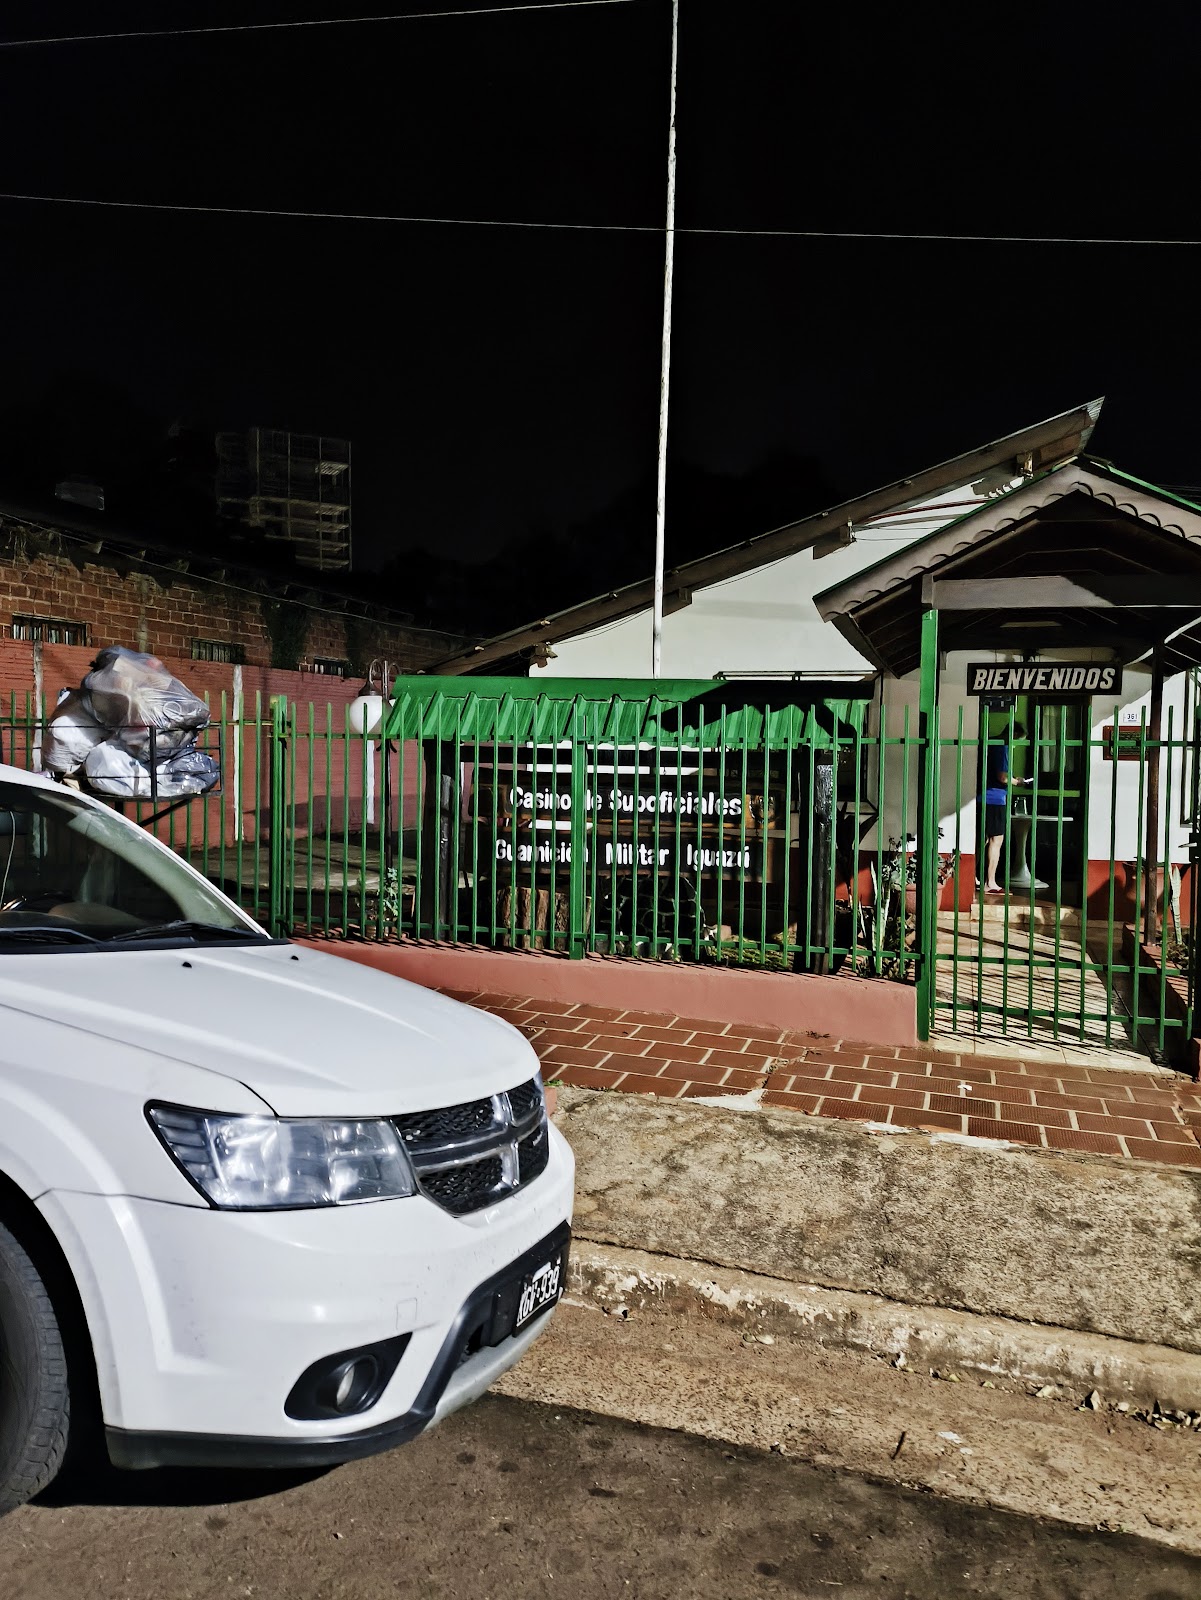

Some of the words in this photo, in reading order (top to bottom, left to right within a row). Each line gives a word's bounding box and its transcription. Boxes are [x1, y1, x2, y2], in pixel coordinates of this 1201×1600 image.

[973, 667, 1116, 691] BIENVENIDOS
[509, 786, 572, 811] Casino
[495, 838, 590, 863] Guarnició
[605, 842, 670, 866] Miltar
[686, 843, 751, 872] Iguazú
